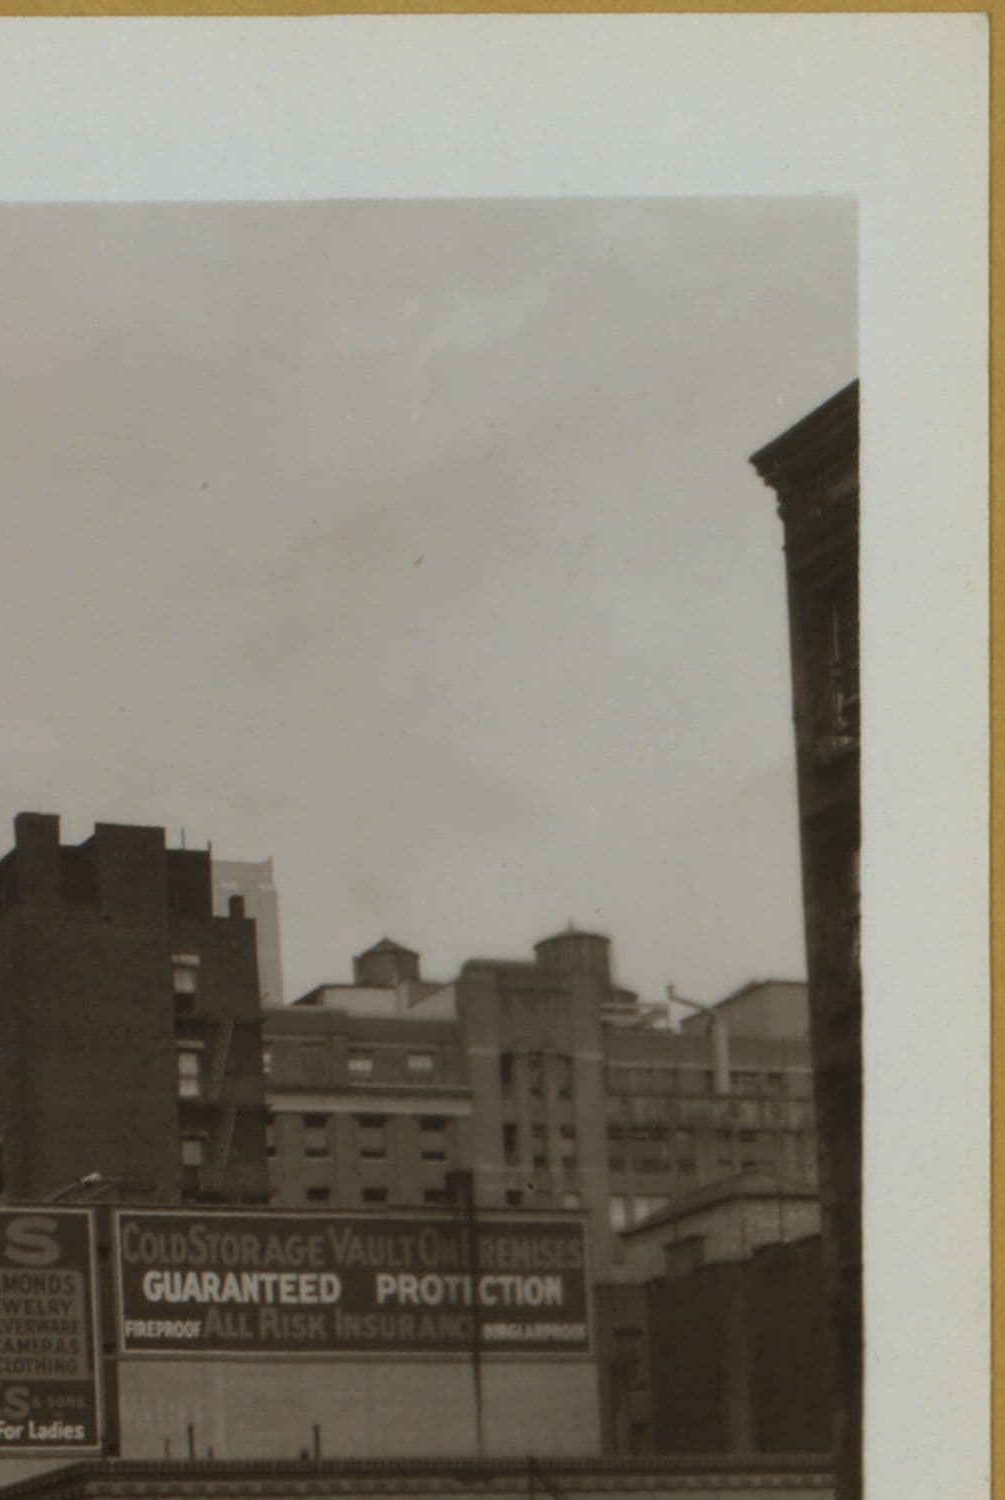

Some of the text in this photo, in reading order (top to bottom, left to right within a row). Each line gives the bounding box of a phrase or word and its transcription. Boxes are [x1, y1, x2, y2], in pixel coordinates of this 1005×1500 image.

[121, 1222, 188, 1264] COLD
[189, 1223, 323, 1267] STORAGE
[328, 1226, 413, 1267] VAULT
[143, 1270, 341, 1304] GUARANTEED
[125, 1319, 202, 1339] FIREPROOF
[204, 1306, 480, 1340] ALL RISK INSURANC
[28, 1420, 86, 1440] Ladies
